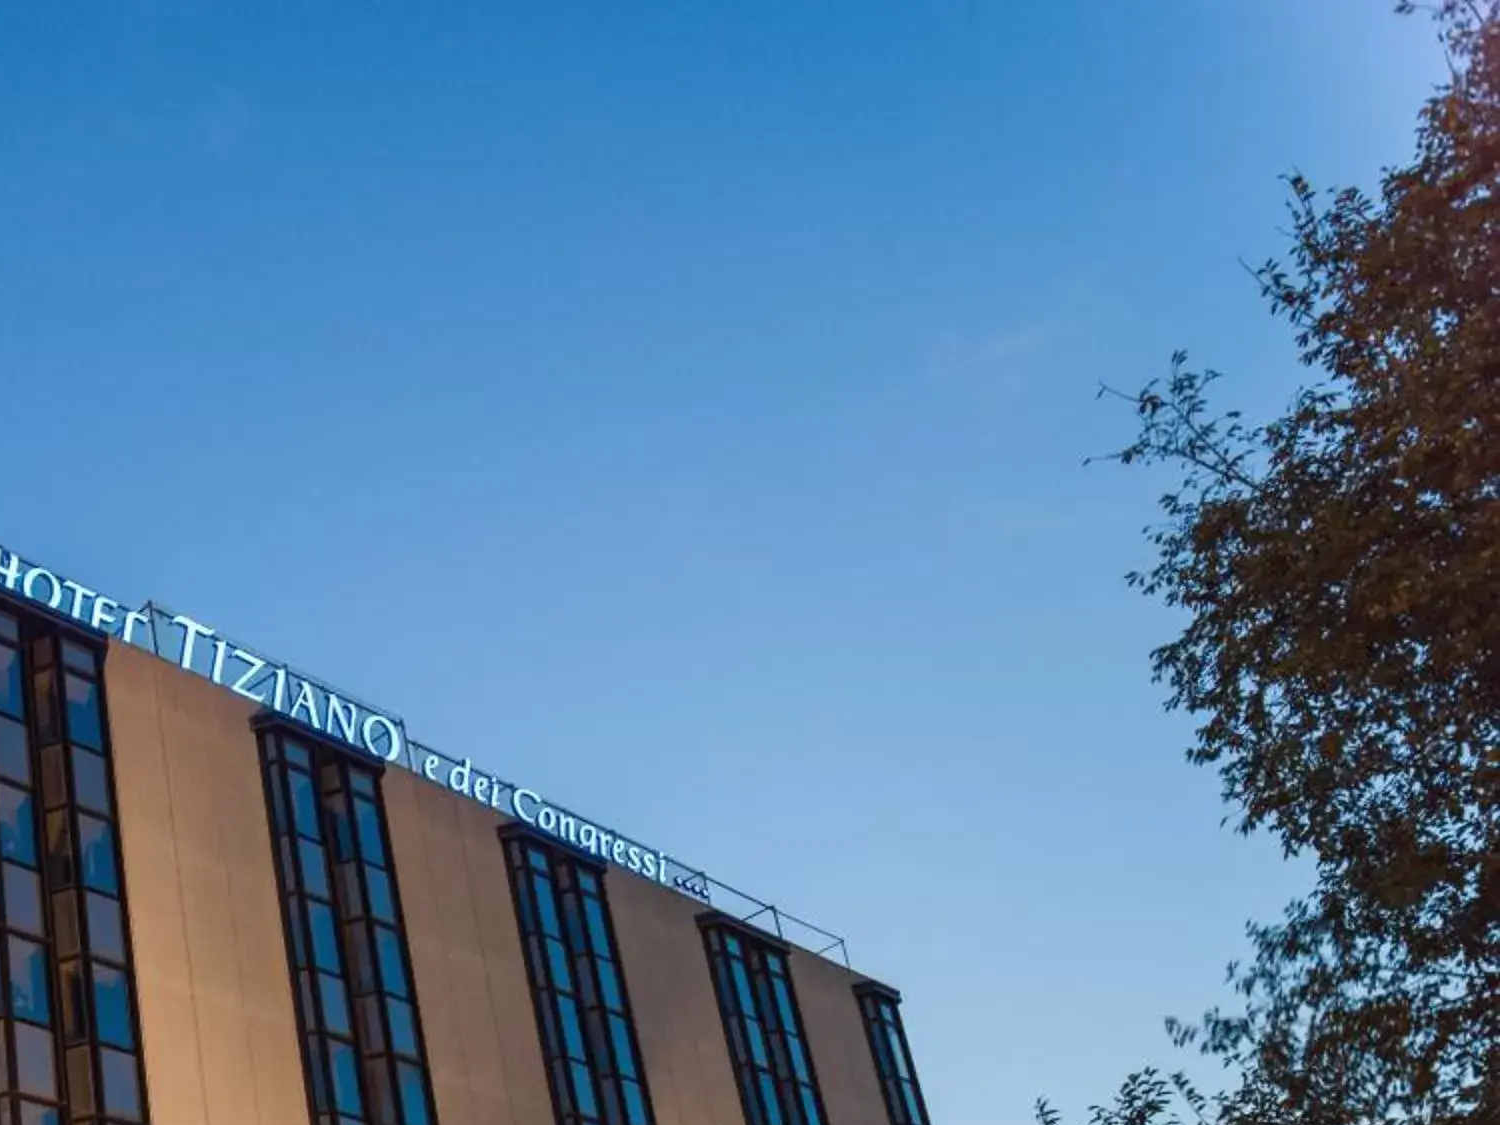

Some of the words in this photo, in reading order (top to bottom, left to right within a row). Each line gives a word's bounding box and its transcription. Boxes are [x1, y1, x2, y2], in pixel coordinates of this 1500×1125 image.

[172, 615, 401, 761] TIZIANO
[424, 755, 440, 781] e
[449, 757, 500, 807] dei
[512, 788, 667, 882] Congressi
